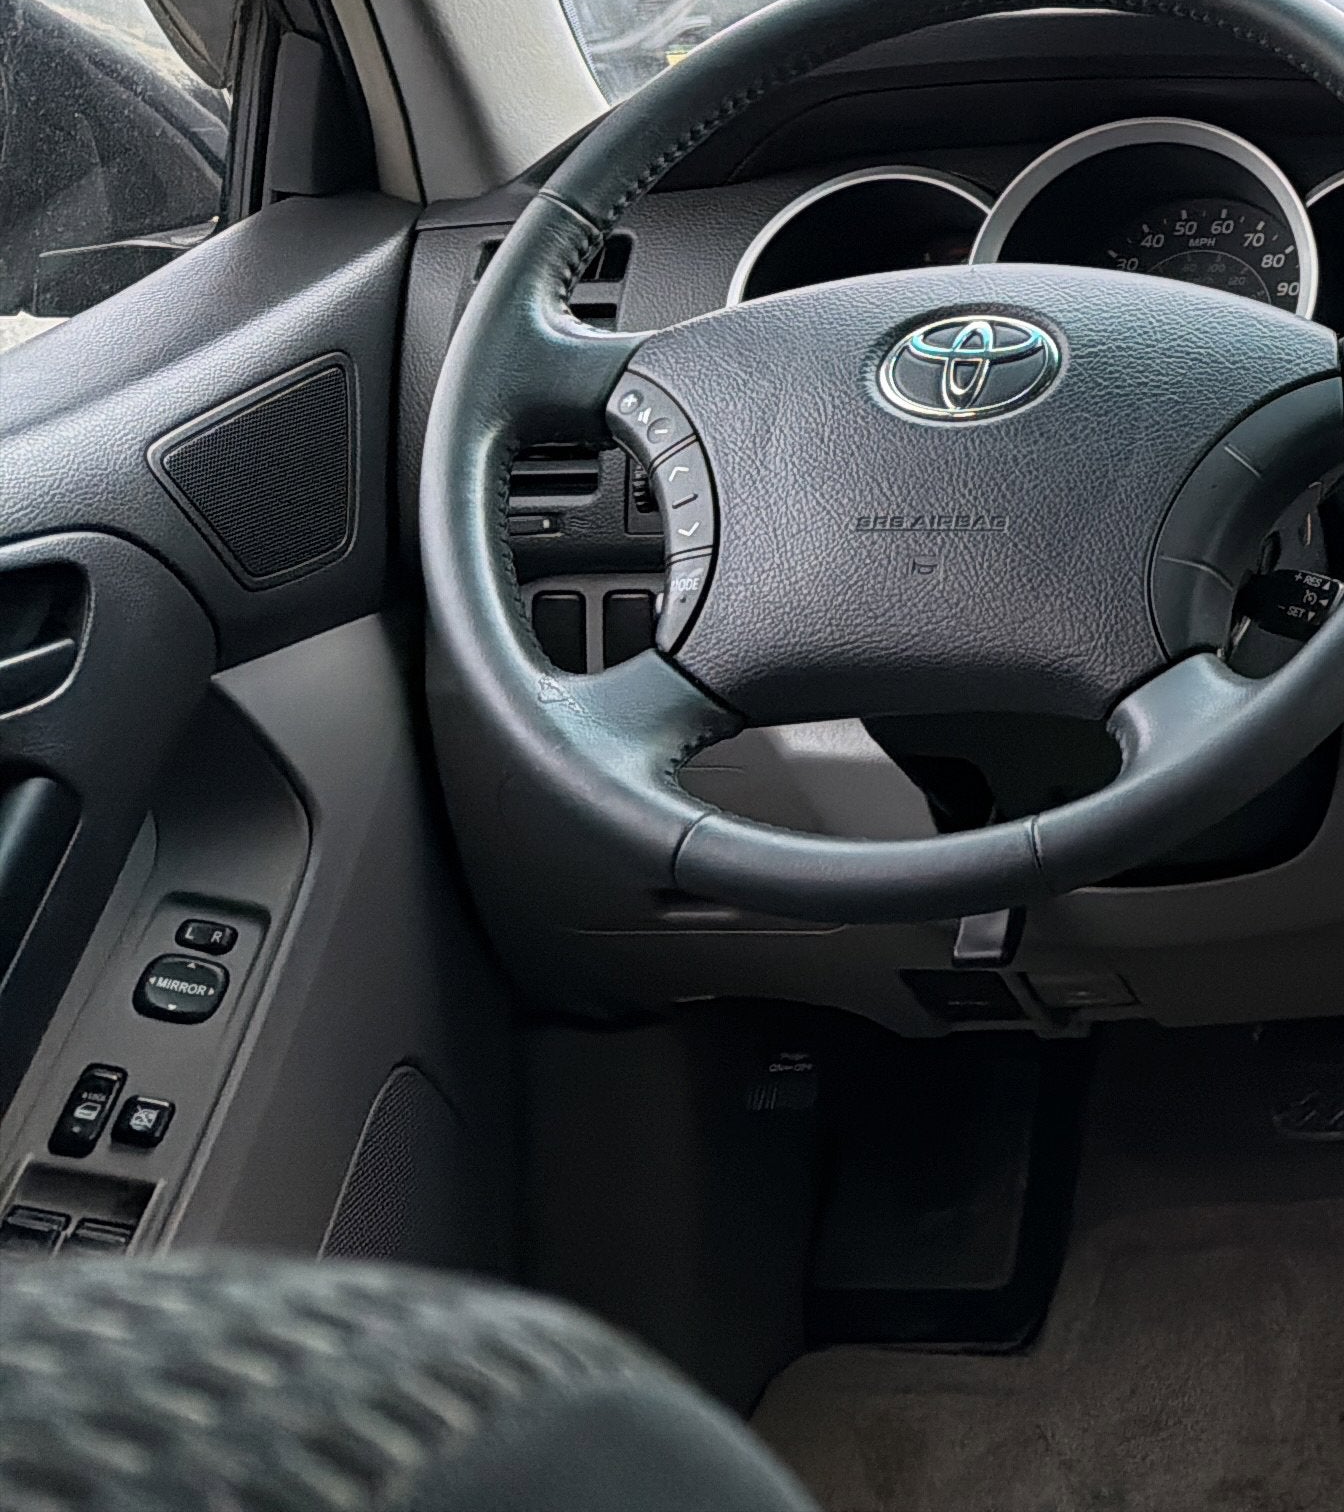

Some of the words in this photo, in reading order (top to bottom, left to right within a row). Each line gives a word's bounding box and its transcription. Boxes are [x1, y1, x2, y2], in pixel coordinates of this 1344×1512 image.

[1172, 221, 1198, 236] 50
[1210, 220, 1235, 234] 60
[1141, 234, 1165, 248] 40
[1188, 238, 1216, 247] MPH
[1243, 233, 1265, 247] 70
[1261, 254, 1285, 268] 80
[1276, 282, 1300, 296] 90
[911, 515, 1009, 530] AIRBAG
[1303, 574, 1323, 588] RES
[1286, 604, 1305, 618] SET
[185, 926, 194, 939] L
[211, 930, 223, 943] R
[155, 976, 208, 996] MIRROR
